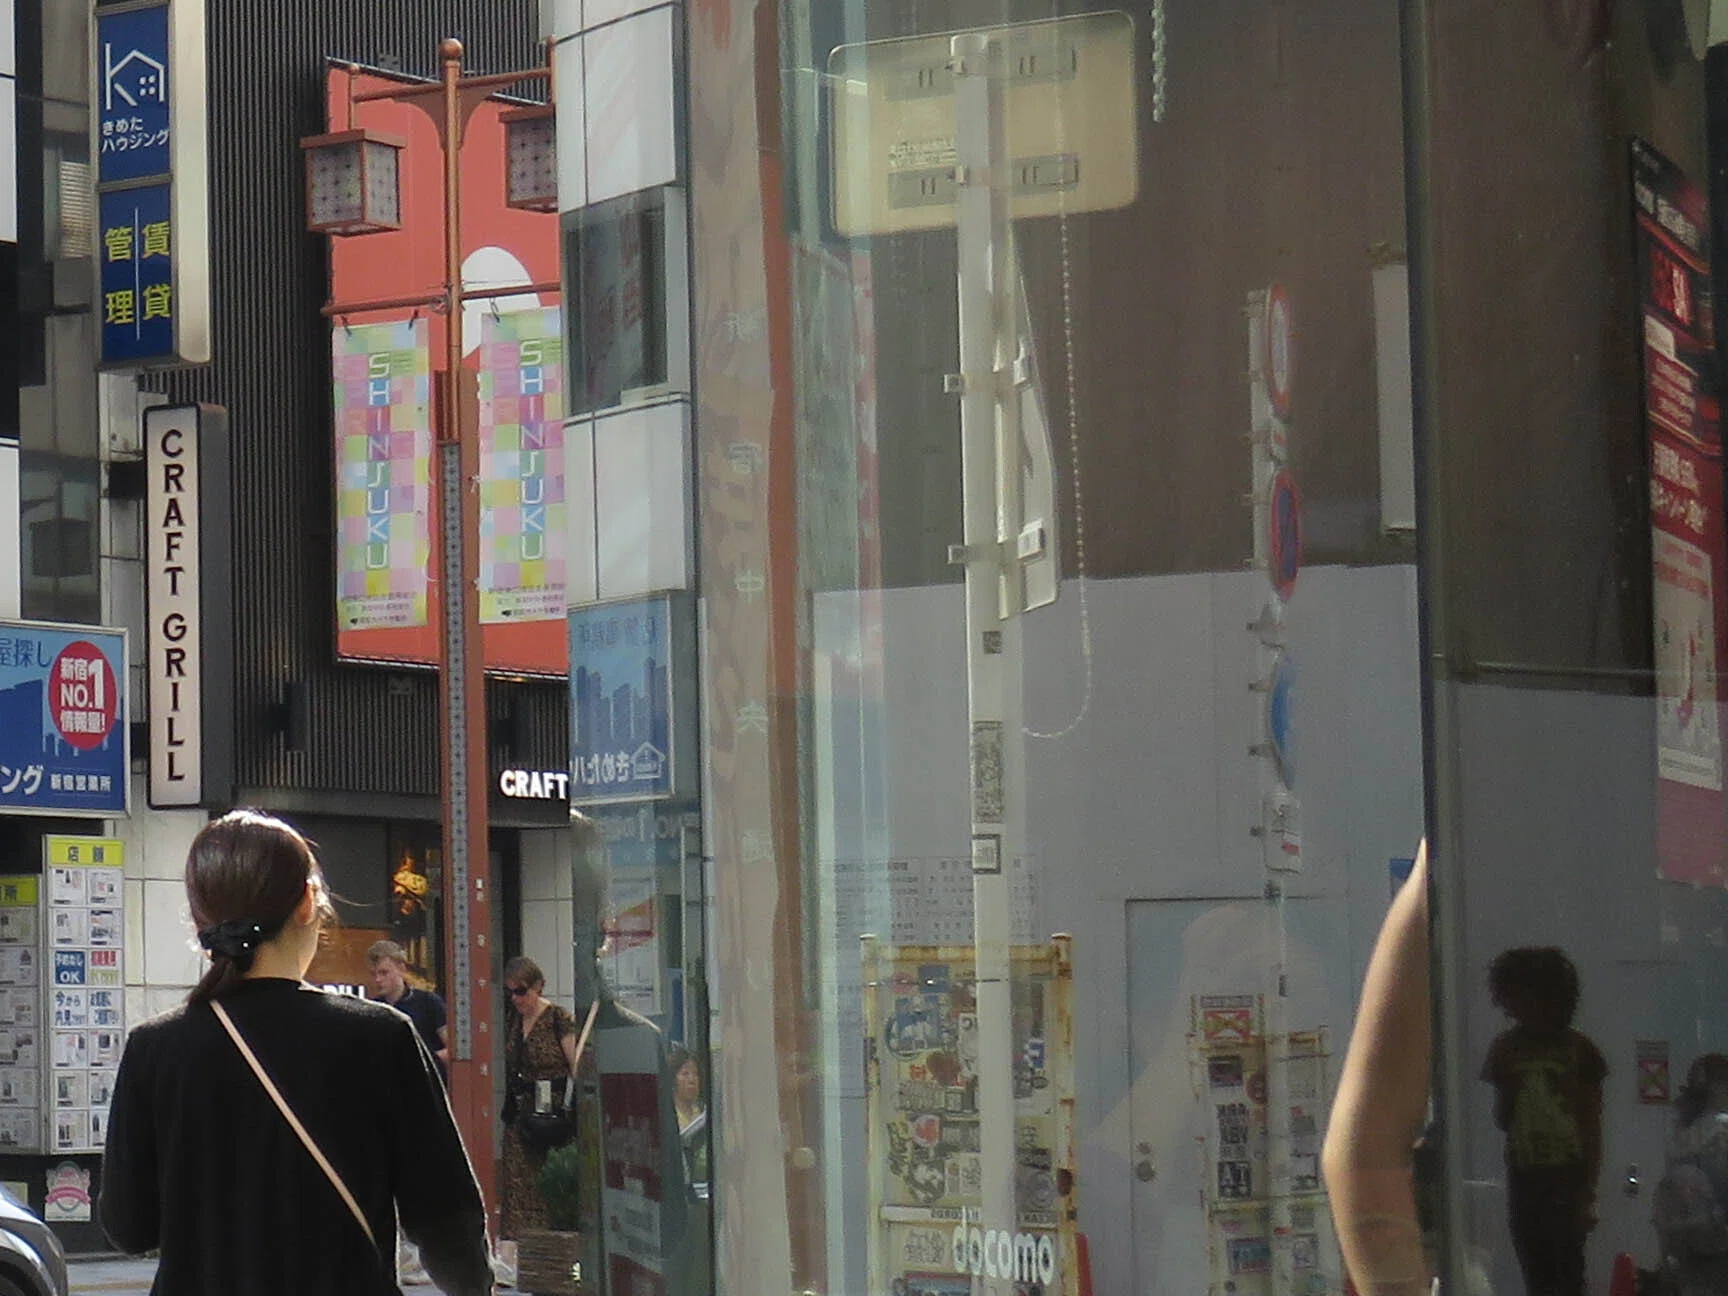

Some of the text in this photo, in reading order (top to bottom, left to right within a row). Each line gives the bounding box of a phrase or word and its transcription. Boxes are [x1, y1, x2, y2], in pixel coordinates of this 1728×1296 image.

[101, 115, 144, 137] きめた
[101, 128, 170, 154] ハウジング
[104, 225, 135, 326] 管理
[141, 220, 172, 321] 賃貸
[367, 352, 391, 570] SHINJUKU
[519, 339, 544, 561] SHINJUKU
[159, 428, 188, 782] CRAFT GRILL
[60, 657, 87, 681] 新宿
[60, 658, 105, 710] NO.1
[499, 769, 569, 800] CRAFT
[59, 970, 81, 984] OK
[951, 1205, 1055, 1286] docomo
